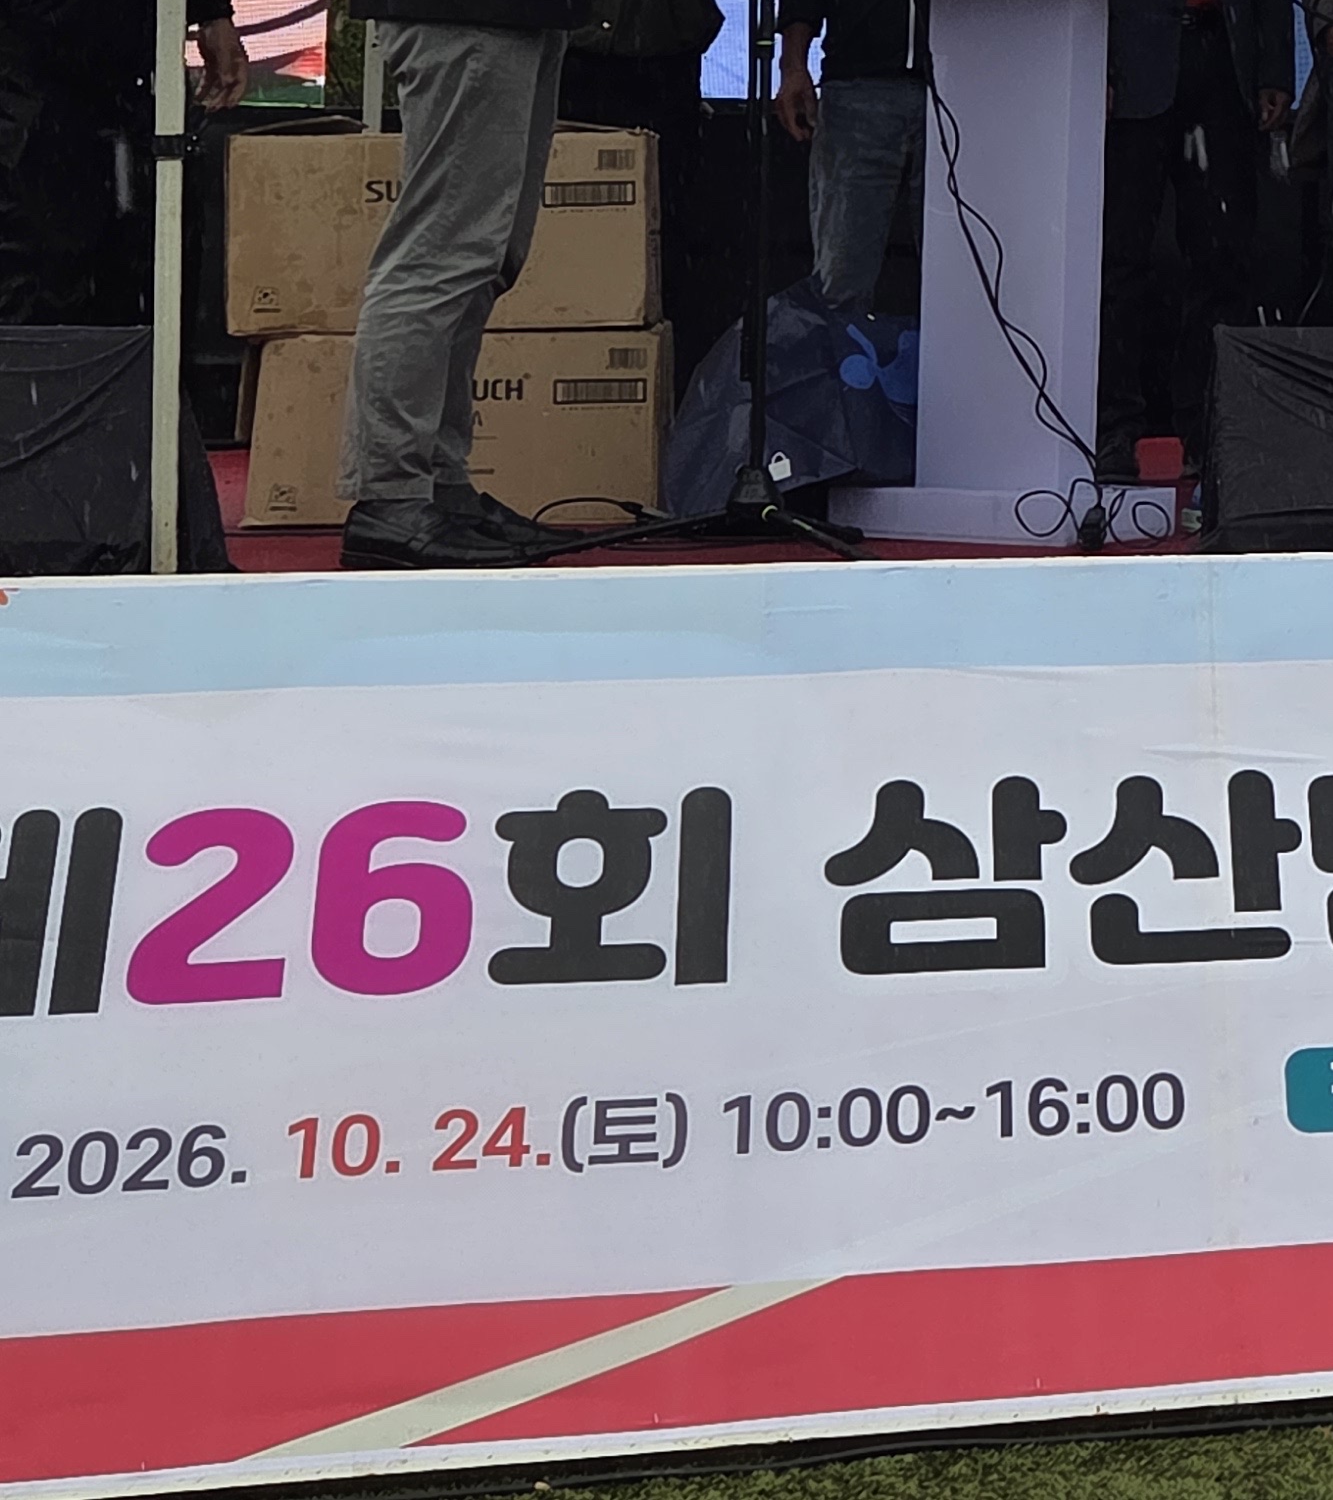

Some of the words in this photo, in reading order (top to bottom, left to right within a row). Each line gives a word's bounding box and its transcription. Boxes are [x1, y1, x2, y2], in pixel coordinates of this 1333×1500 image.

[10, 1123, 248, 1198] 2026.
[287, 1113, 400, 1180] 10.
[722, 1072, 1186, 1156] 10:00~16:00
